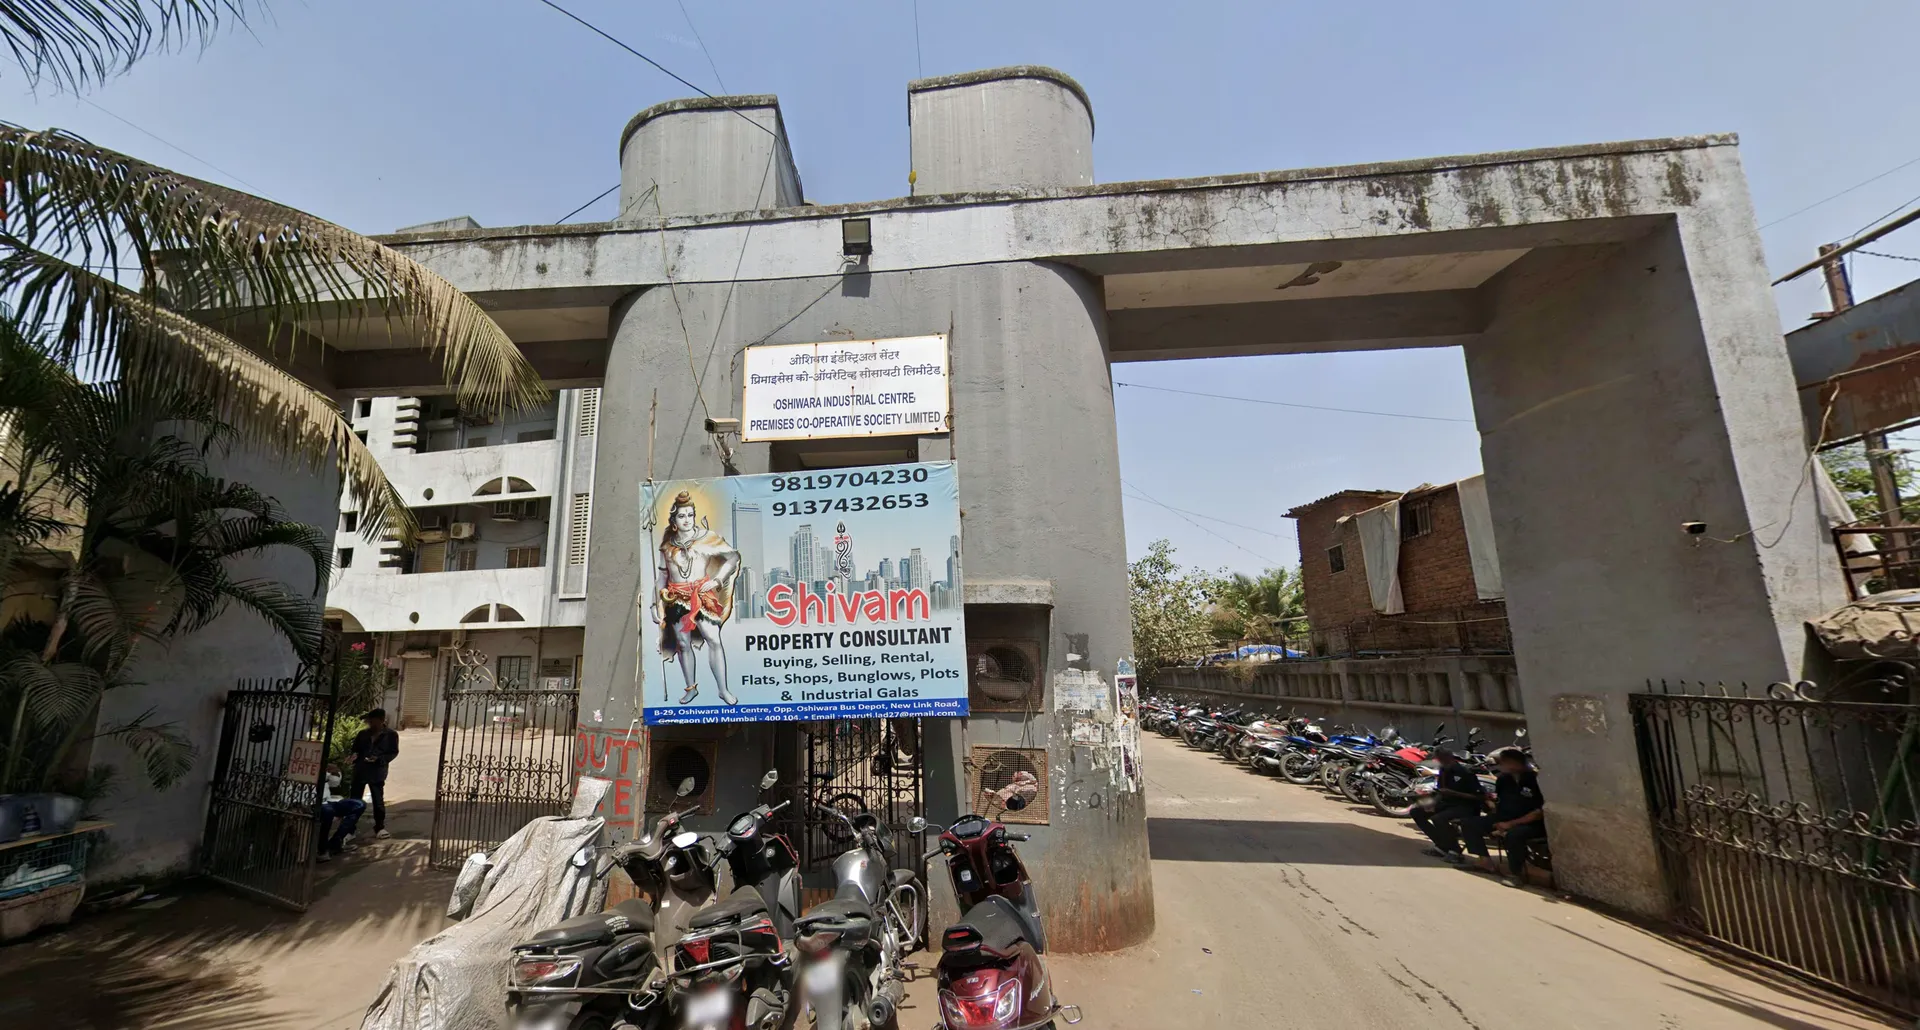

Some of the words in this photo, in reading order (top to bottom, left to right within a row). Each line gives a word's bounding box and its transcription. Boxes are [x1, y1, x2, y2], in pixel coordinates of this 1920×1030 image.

[789, 354, 828, 365] ओशिवरा
[879, 349, 900, 360] सेंटर
[751, 372, 793, 385] प्रिमाइसेस
[860, 366, 901, 379] सोसायटी
[903, 363, 941, 376] लिमीटेड
[776, 397, 822, 410] OSHIWARA
[824, 394, 876, 407] INDUSTRIAL
[878, 392, 914, 405] CENTRE
[750, 418, 794, 431] PREMISES
[797, 415, 861, 429] CO-OPERATIVE
[863, 412, 902, 426] SOCIETY
[905, 411, 941, 424] LIMITED
[771, 467, 929, 492] 9819704230
[772, 493, 929, 517] 9137432653
[766, 581, 931, 628] Shivam
[745, 632, 834, 652] PROPERTY
[840, 627, 952, 648] CONSULTANT
[763, 656, 818, 669] Buying,
[822, 654, 876, 667] Selling,
[881, 651, 935, 664] Rental,
[741, 674, 780, 686] Flats,
[784, 673, 833, 685] Shops,
[837, 669, 916, 684] Bunglows,
[920, 668, 959, 680] Plots
[781, 690, 793, 701] &
[801, 688, 872, 701] Industrial
[877, 687, 919, 698] Galas
[678, 708, 719, 716] Oshiwara
[797, 704, 838, 712] Oshiwara
[858, 703, 889, 711] Depot,
[934, 700, 961, 708] Road,
[702, 716, 718, 724] (W)
[721, 715, 757, 723] Mumbai
[575, 732, 639, 774] OUT
